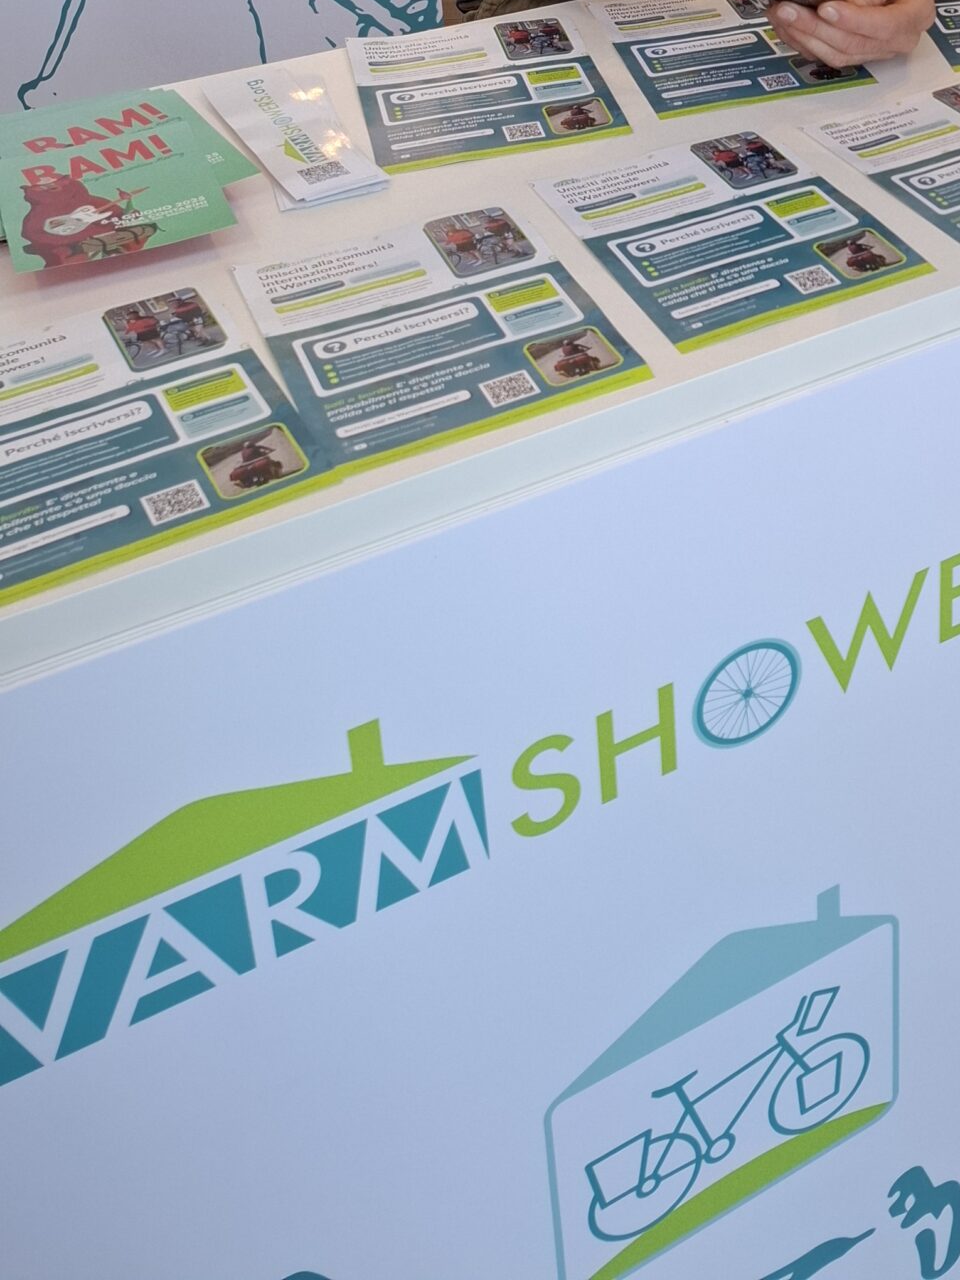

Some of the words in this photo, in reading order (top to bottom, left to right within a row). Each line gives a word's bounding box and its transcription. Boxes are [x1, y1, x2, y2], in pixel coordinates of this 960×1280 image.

[556, 180, 599, 193] Unisciti
[621, 162, 669, 178] comunità
[561, 177, 639, 199] internazionale
[578, 176, 660, 201] Warmshowers!
[660, 230, 700, 245] Perché
[700, 214, 755, 233] iscriversi?
[258, 265, 308, 281] Unisciti
[311, 260, 333, 268] alla
[336, 243, 394, 262] comunità
[261, 262, 355, 287] internazionale
[278, 261, 378, 290] Warmshowers!
[353, 327, 401, 345] Perché
[404, 307, 469, 330] iscriversi?
[408, 365, 464, 385] divertente
[325, 388, 414, 418] probabilmente
[454, 363, 490, 377] doccia
[365, 402, 386, 412] che
[5, 434, 61, 457] Perché
[64, 407, 142, 438] iscriversi?
[60, 475, 127, 501] divertente
[87, 486, 112, 500] una
[114, 472, 157, 492] doccia
[6, 523, 31, 536] che
